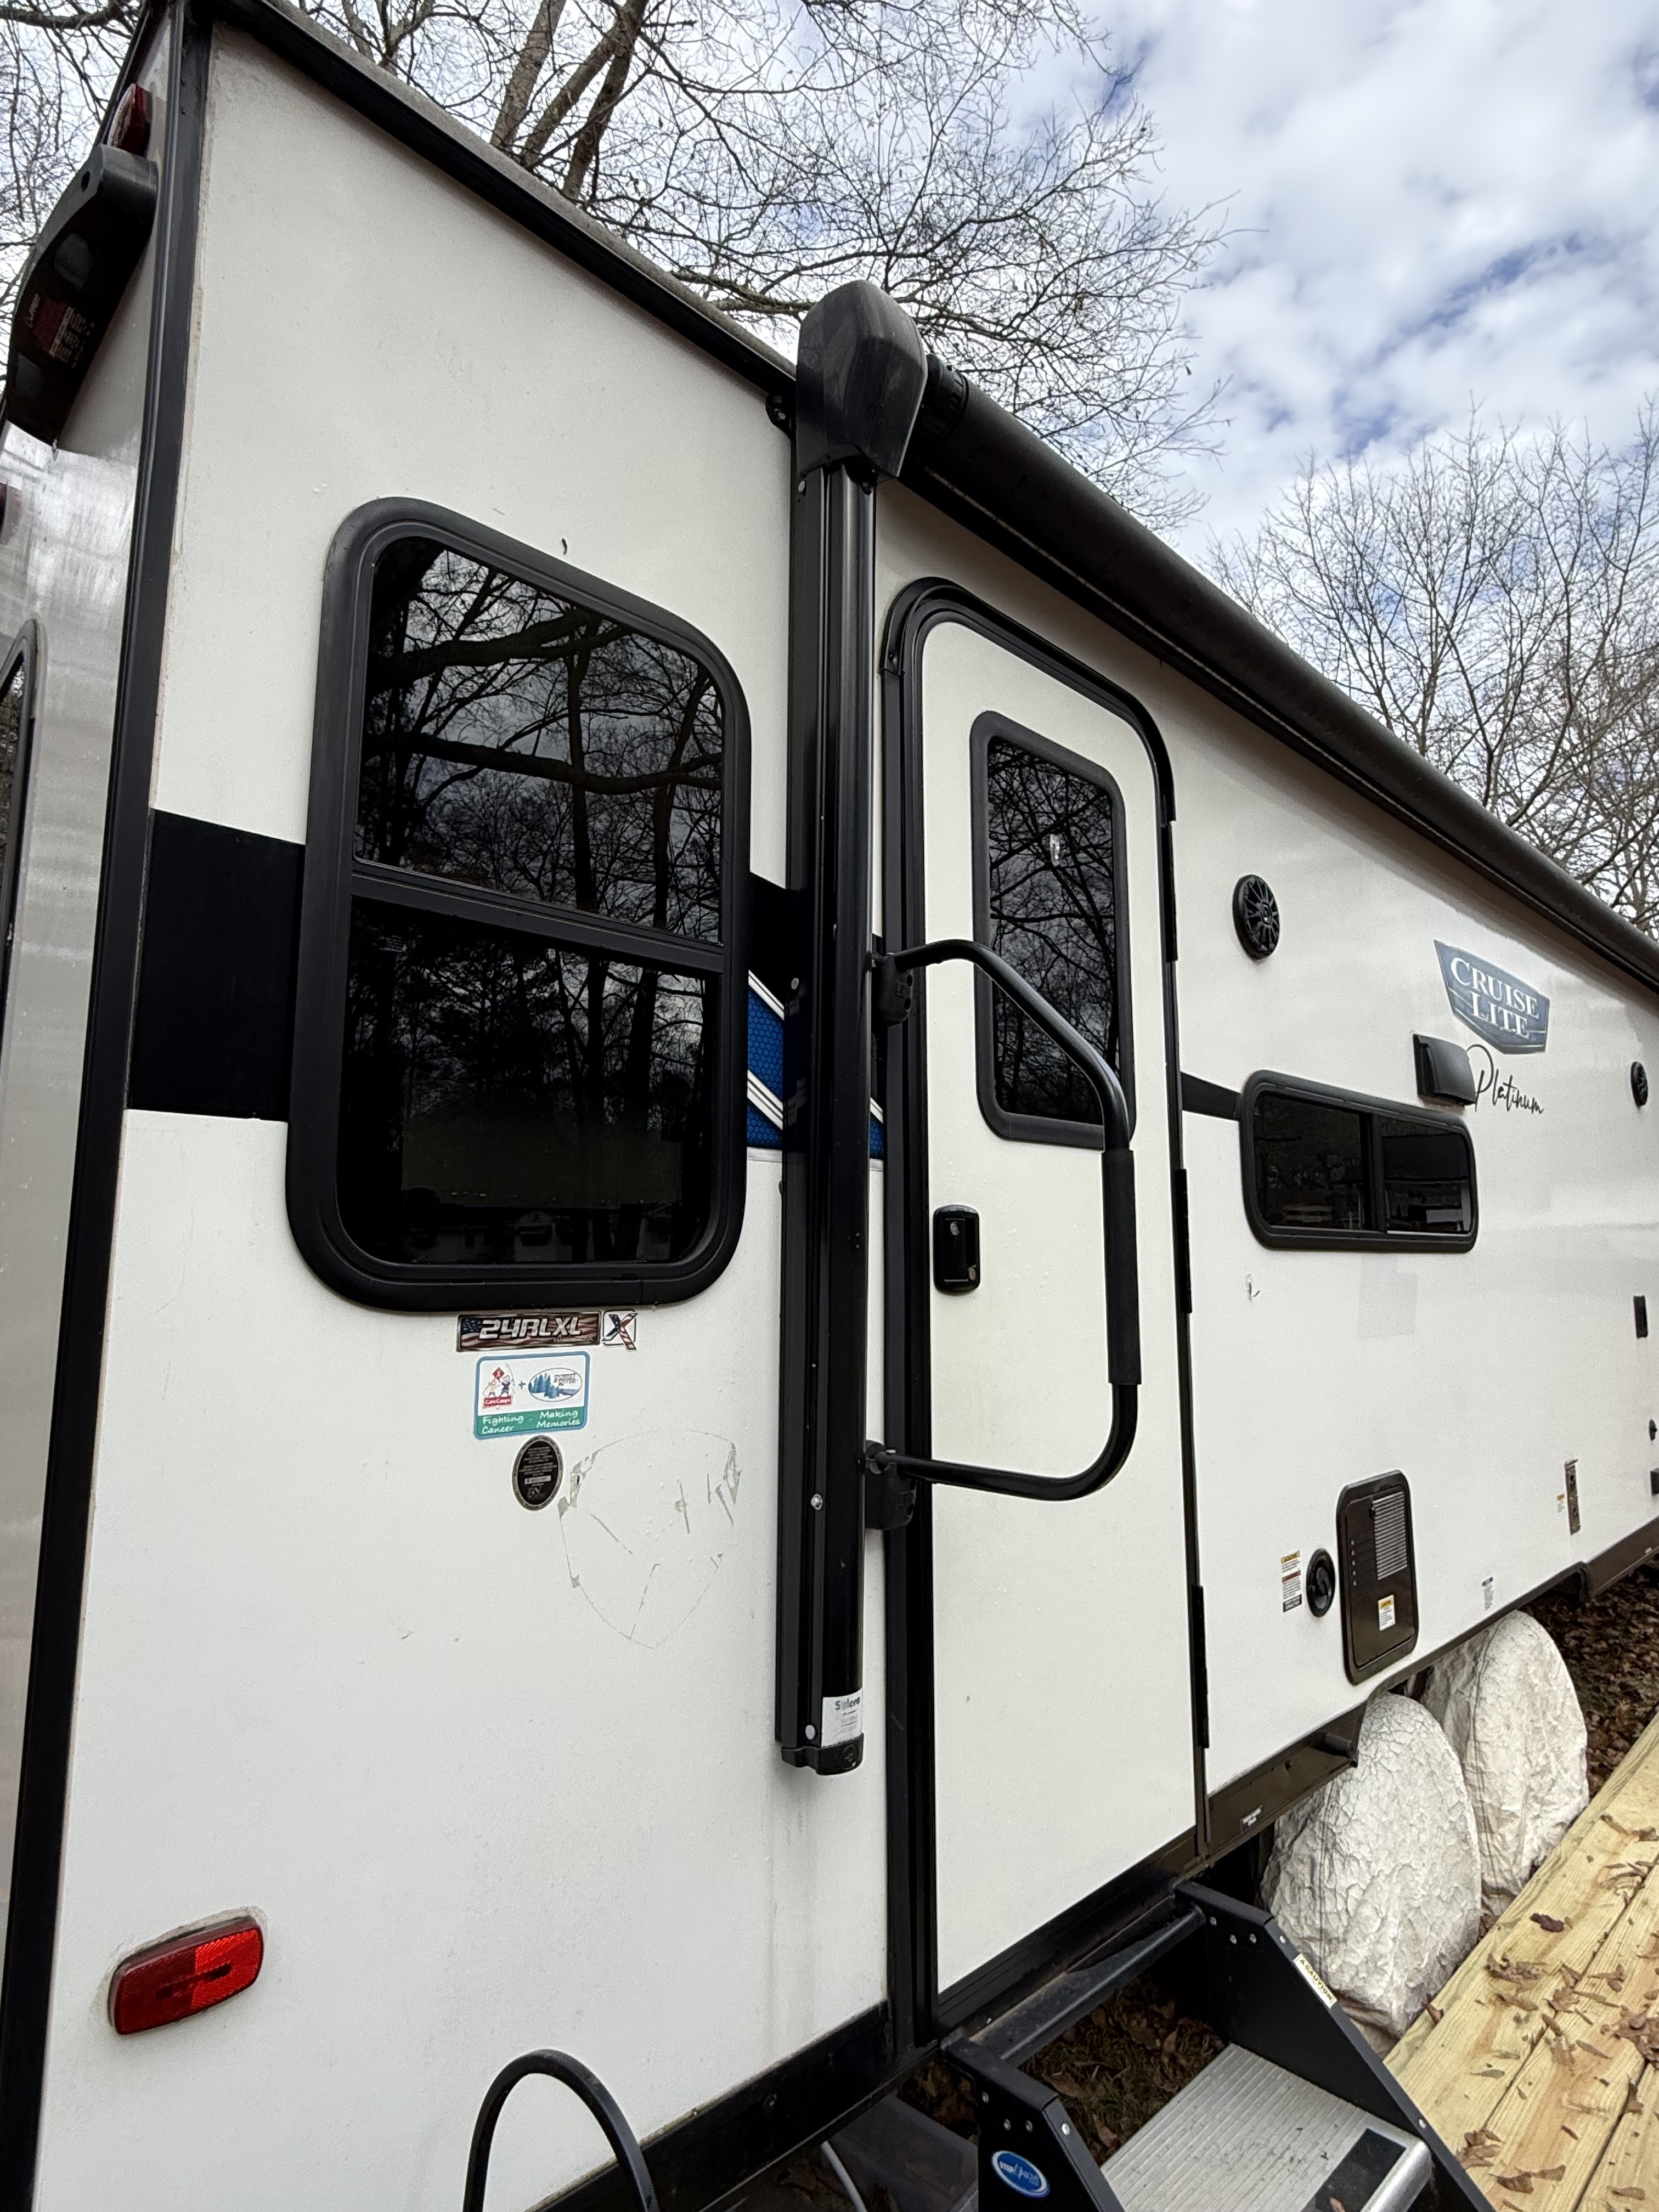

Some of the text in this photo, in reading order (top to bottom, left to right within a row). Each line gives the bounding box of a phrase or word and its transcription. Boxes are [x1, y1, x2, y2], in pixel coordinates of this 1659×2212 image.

[1450, 957, 1539, 1019] CRUISE
[1470, 990, 1530, 1039] LITE
[1466, 1043, 1544, 1115] Platinum
[482, 1414, 524, 1426] Fighting
[536, 1418, 580, 1429] Memories
[540, 1409, 578, 1420] Making
[481, 1425, 515, 1435] Cancer
[1305, 1964, 1332, 2001] CAUTION
